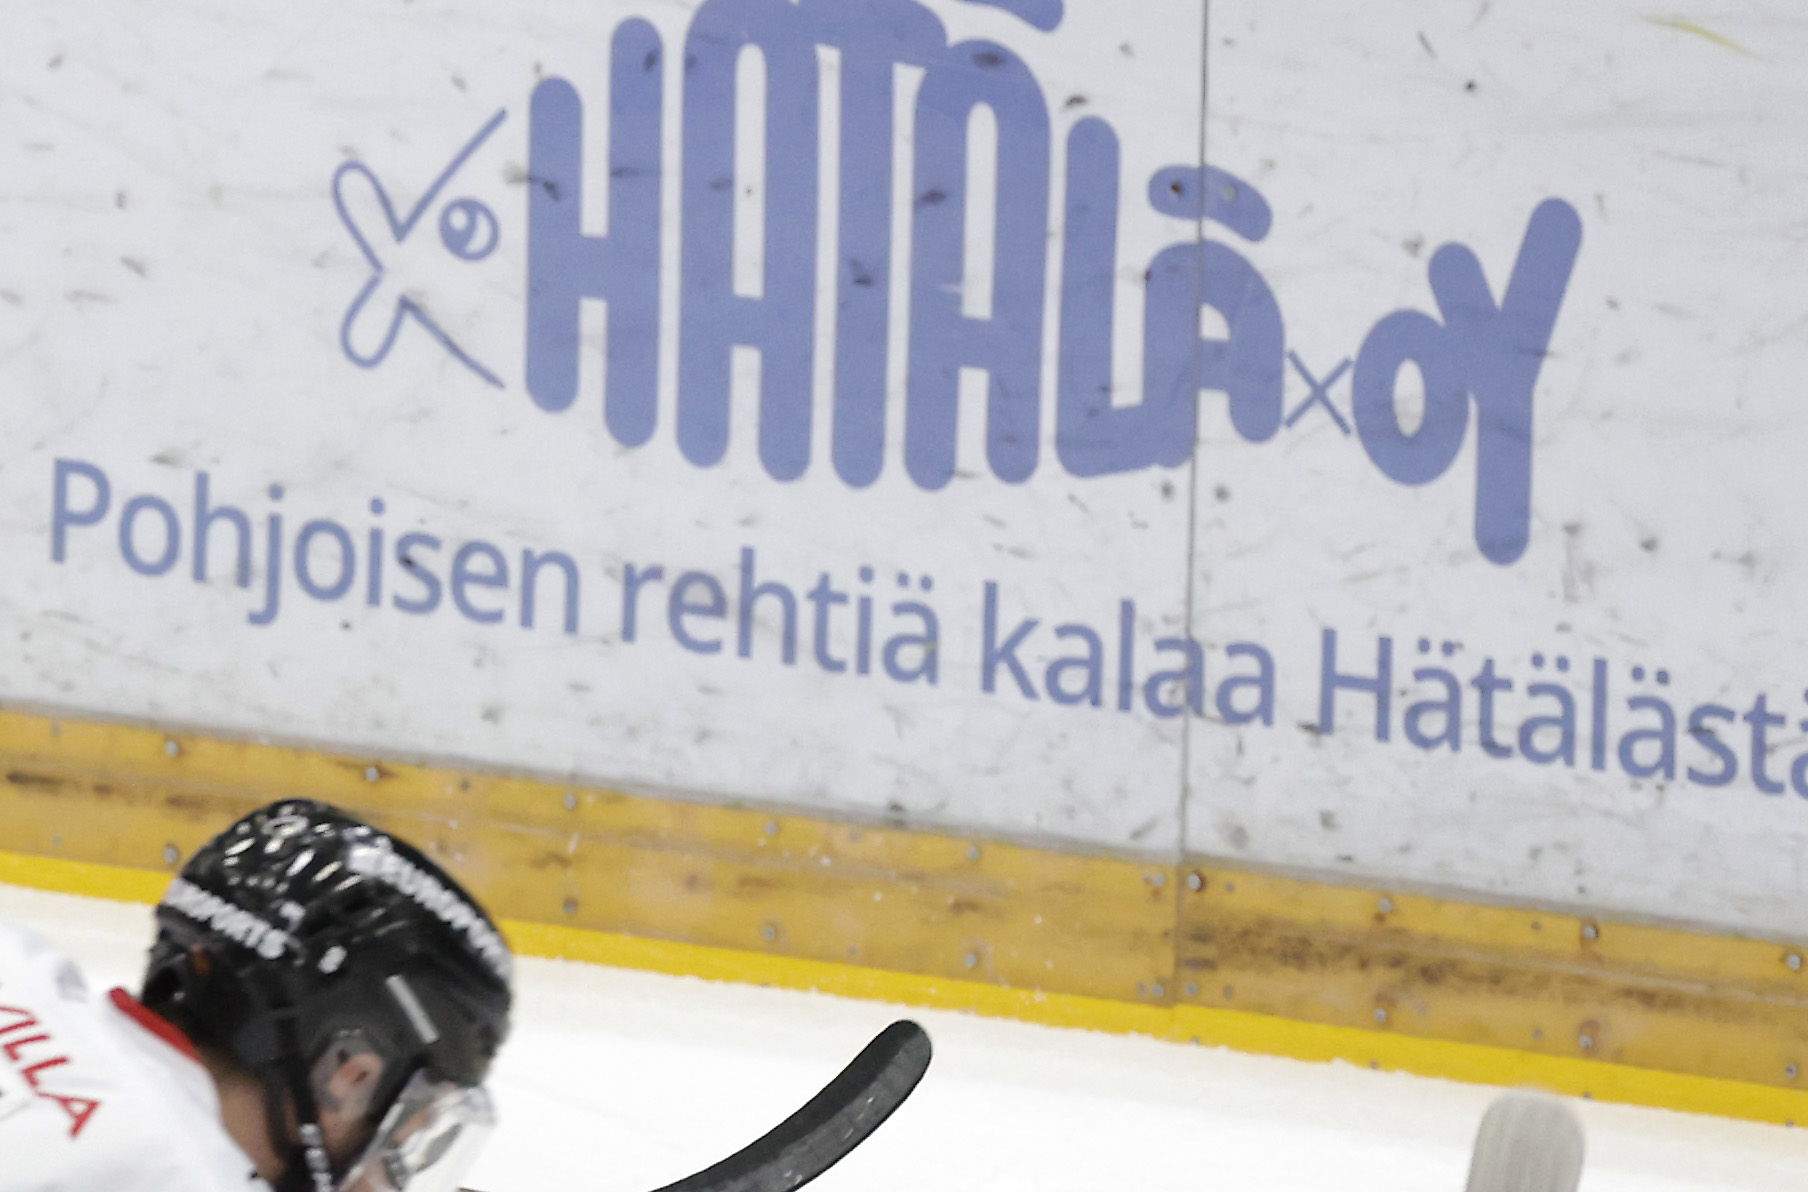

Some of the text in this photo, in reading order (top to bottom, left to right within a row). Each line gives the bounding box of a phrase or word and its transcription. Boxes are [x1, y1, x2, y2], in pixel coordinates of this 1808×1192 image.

[49, 457, 580, 635] Pohjoisen
[621, 546, 940, 685] rehtiä
[980, 580, 1276, 727] kalaa
